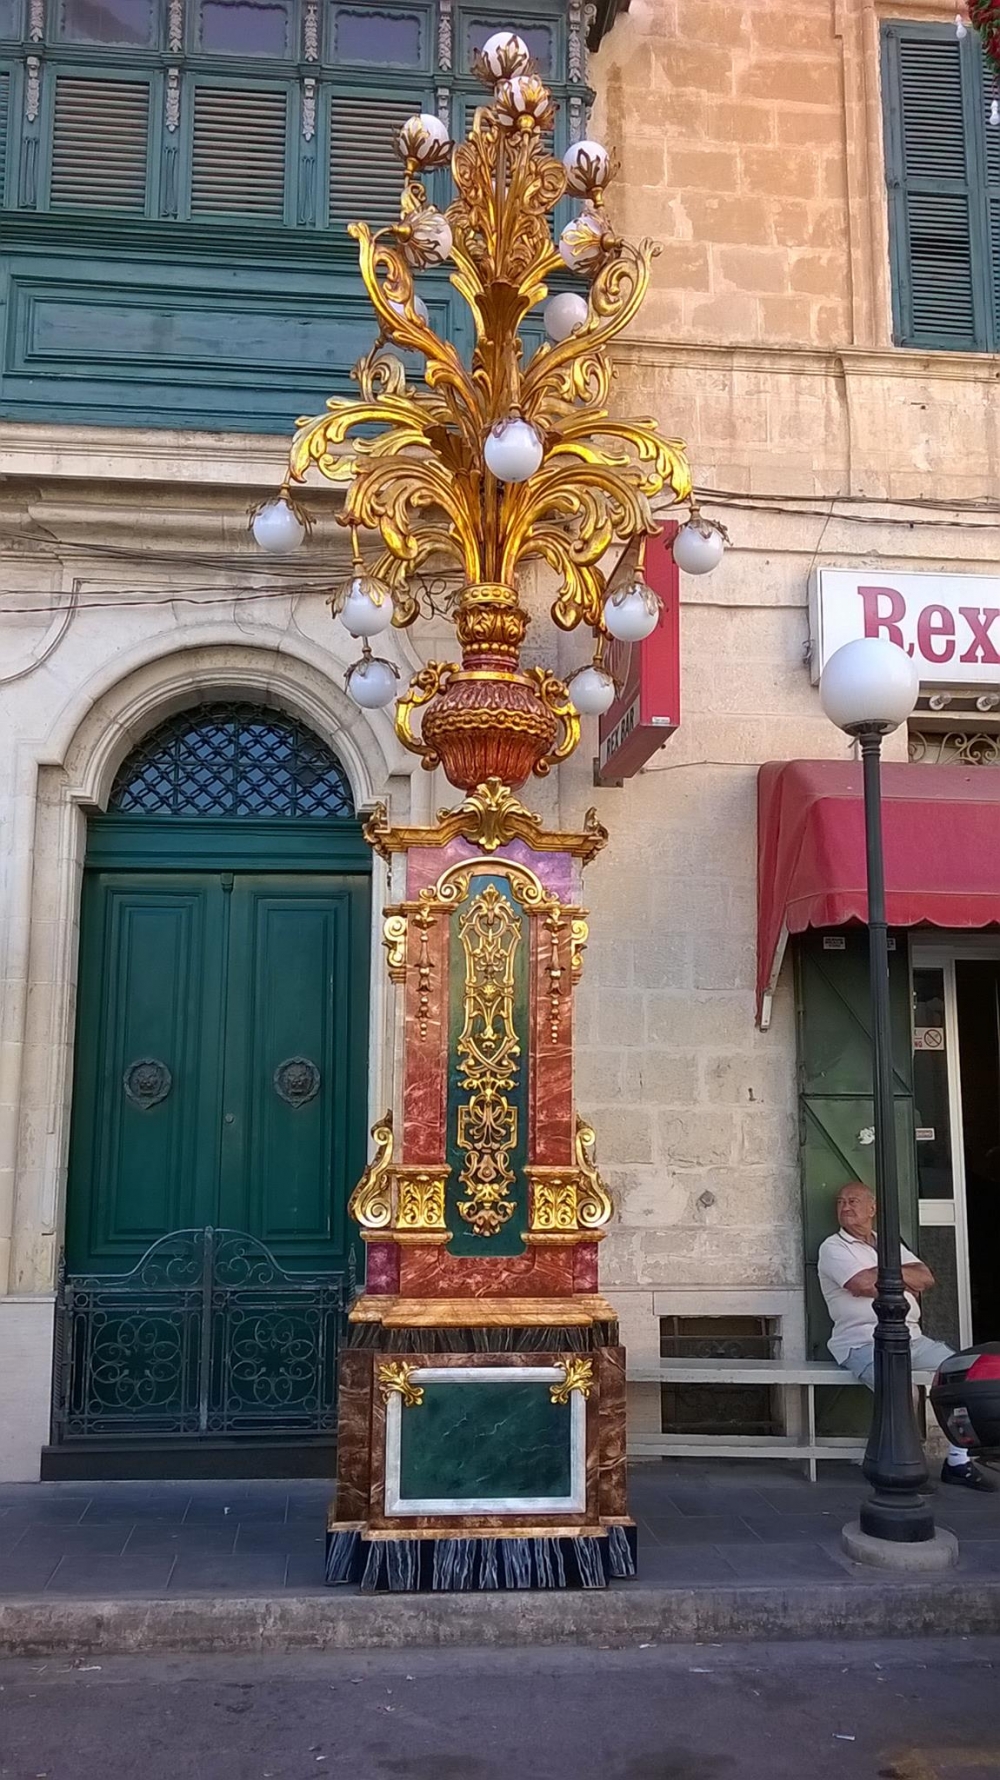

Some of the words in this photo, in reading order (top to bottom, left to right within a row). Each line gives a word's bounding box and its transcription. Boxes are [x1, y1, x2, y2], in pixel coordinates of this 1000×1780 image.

[857, 586, 1000, 664] Rex
[606, 725, 620, 757] REX
[621, 706, 634, 743] BAR
